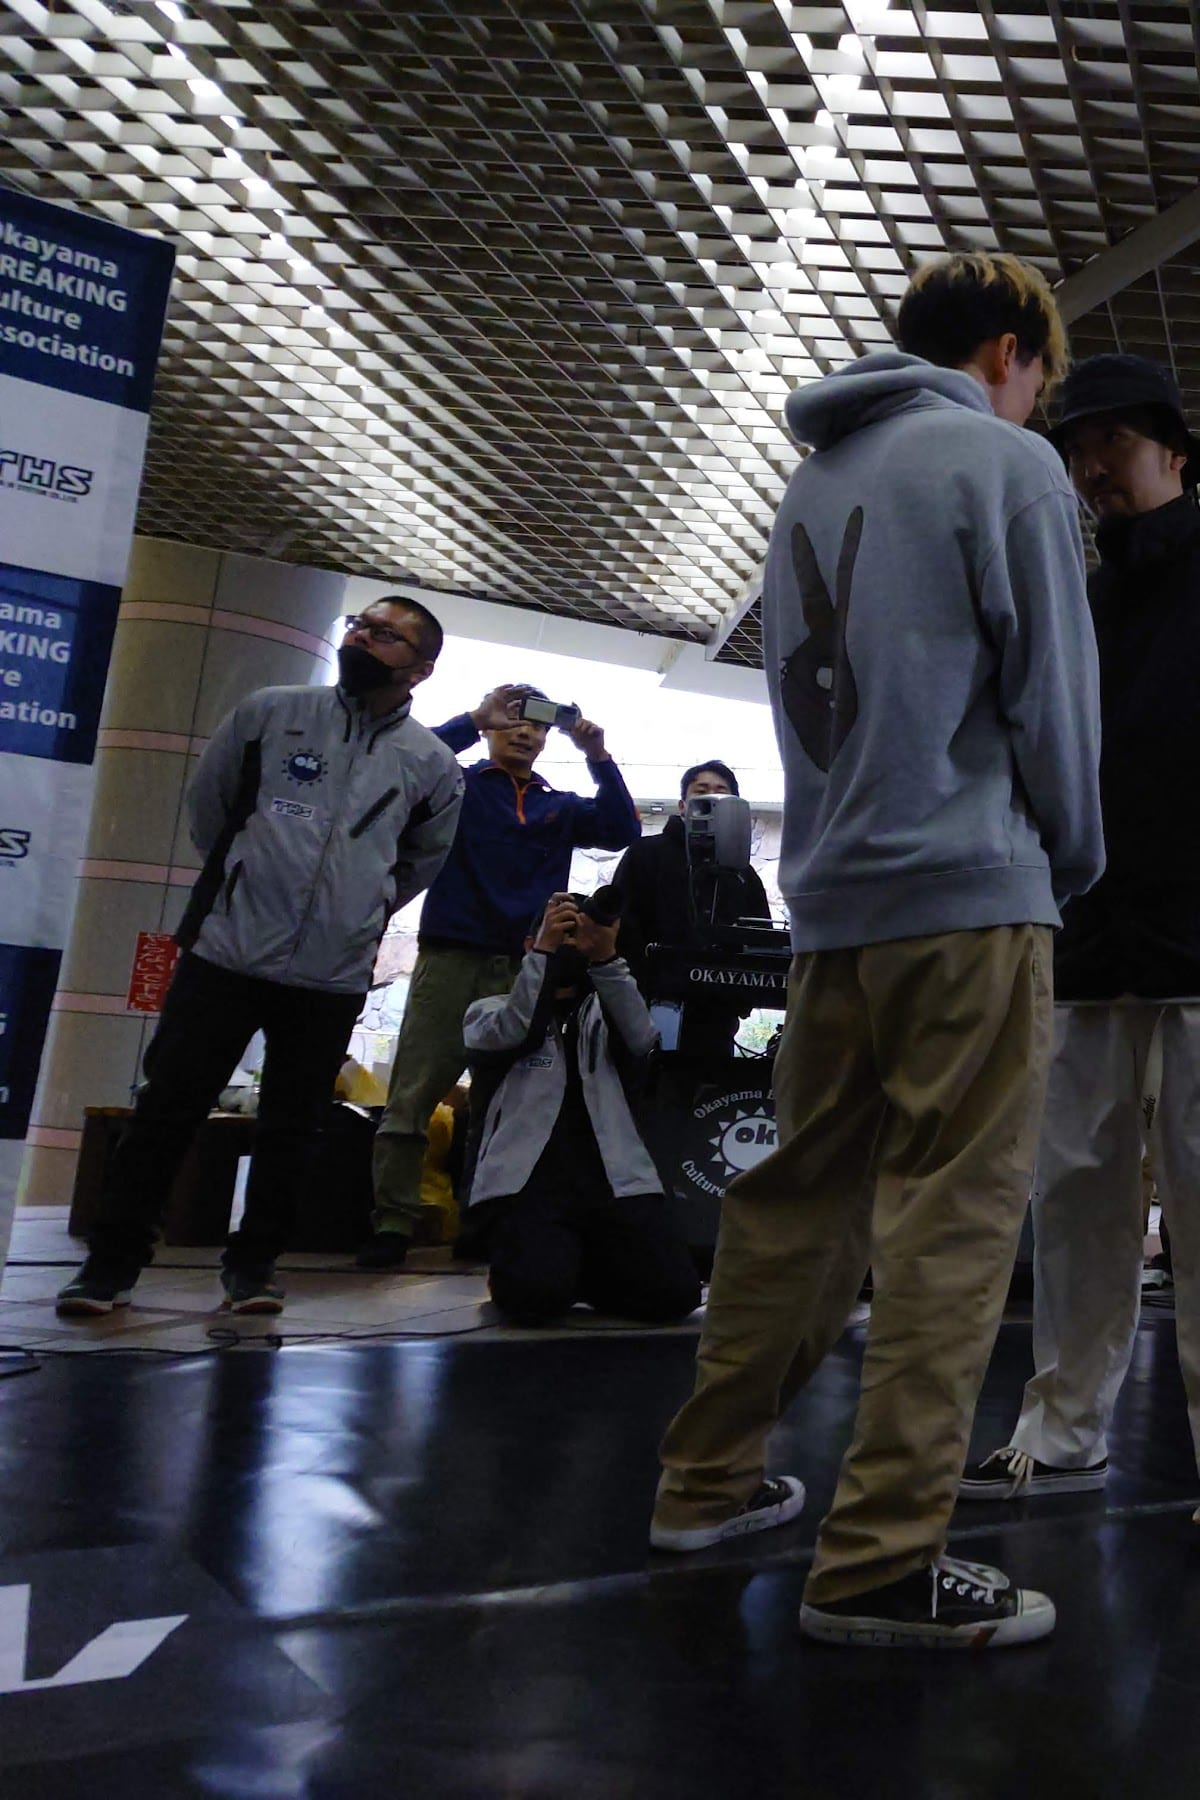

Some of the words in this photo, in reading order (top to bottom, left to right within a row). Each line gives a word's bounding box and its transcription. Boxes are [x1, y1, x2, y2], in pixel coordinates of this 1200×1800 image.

[0, 220, 119, 279] kayama
[0, 324, 135, 377] sociation
[689, 968, 776, 988] OKAYAMA
[693, 1089, 763, 1119] Okayama
[735, 1124, 777, 1145] ok
[681, 1160, 727, 1198] Culture
